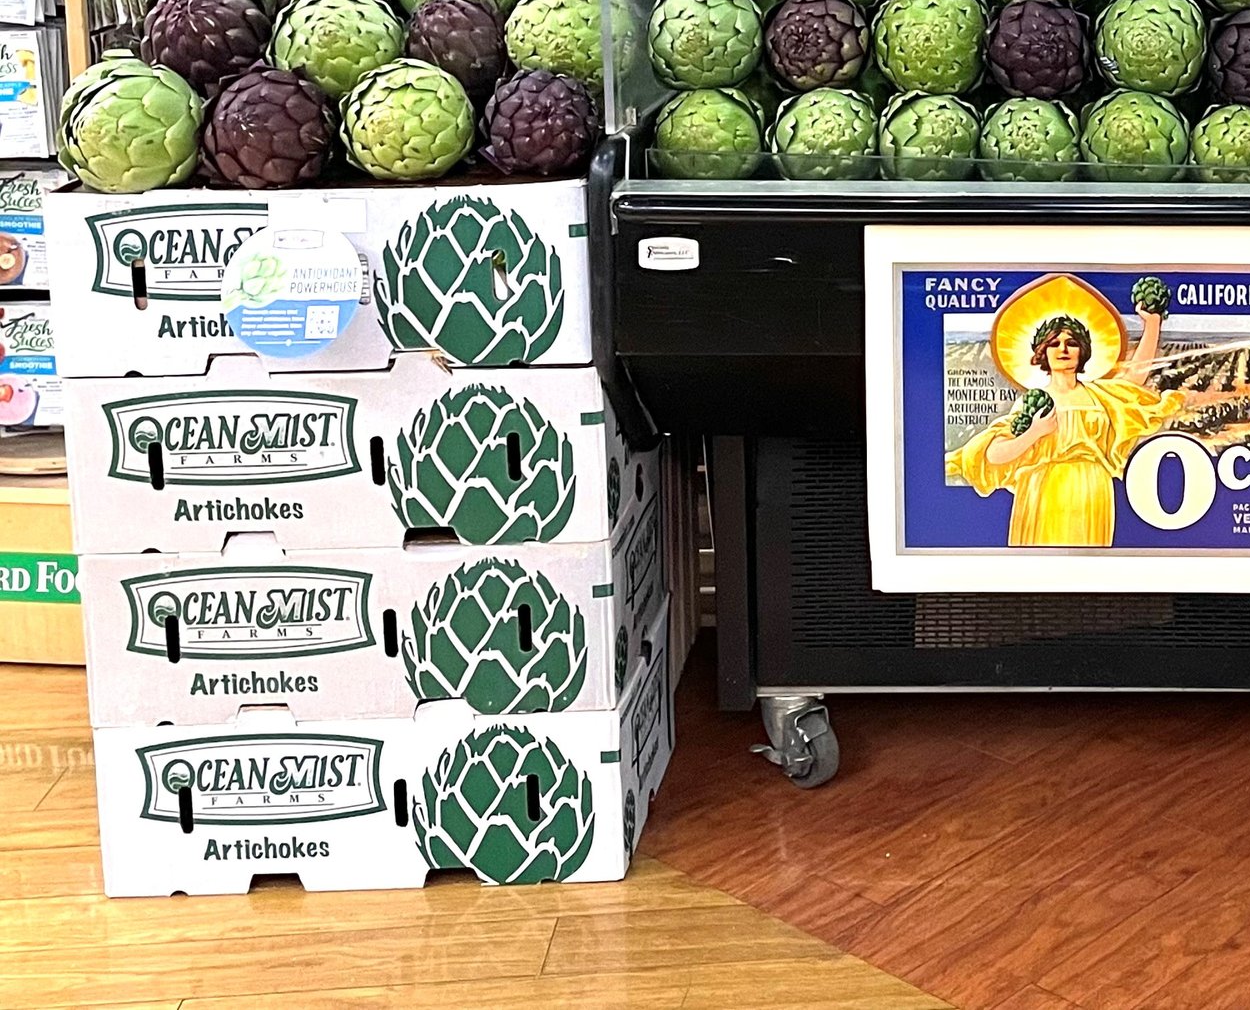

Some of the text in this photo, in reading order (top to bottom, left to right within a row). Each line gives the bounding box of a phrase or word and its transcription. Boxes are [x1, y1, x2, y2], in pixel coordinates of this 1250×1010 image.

[113, 228, 223, 267] OCEAN
[293, 268, 358, 279] ANTIOXIDANT
[290, 281, 358, 294] POWERHOUSE
[925, 277, 1002, 292] FANCY
[925, 294, 1000, 310] QUALITY
[158, 313, 234, 338] Artich
[948, 377, 995, 387] THE FAMOUS
[947, 389, 1018, 401] MONTEREY BAY
[948, 403, 999, 413] ARTICHOKE
[947, 415, 989, 425] DISTRICT
[129, 413, 338, 455] OCEAN MIST
[179, 452, 299, 466] FARMS
[174, 496, 304, 522] Artichokes
[147, 588, 352, 629] OCEAN MIST
[198, 627, 314, 639] FARMS
[190, 670, 318, 696] Artichokes
[161, 753, 364, 795] OCEAN MIST
[211, 793, 326, 805] FARMS
[204, 836, 330, 862] Artichokes
